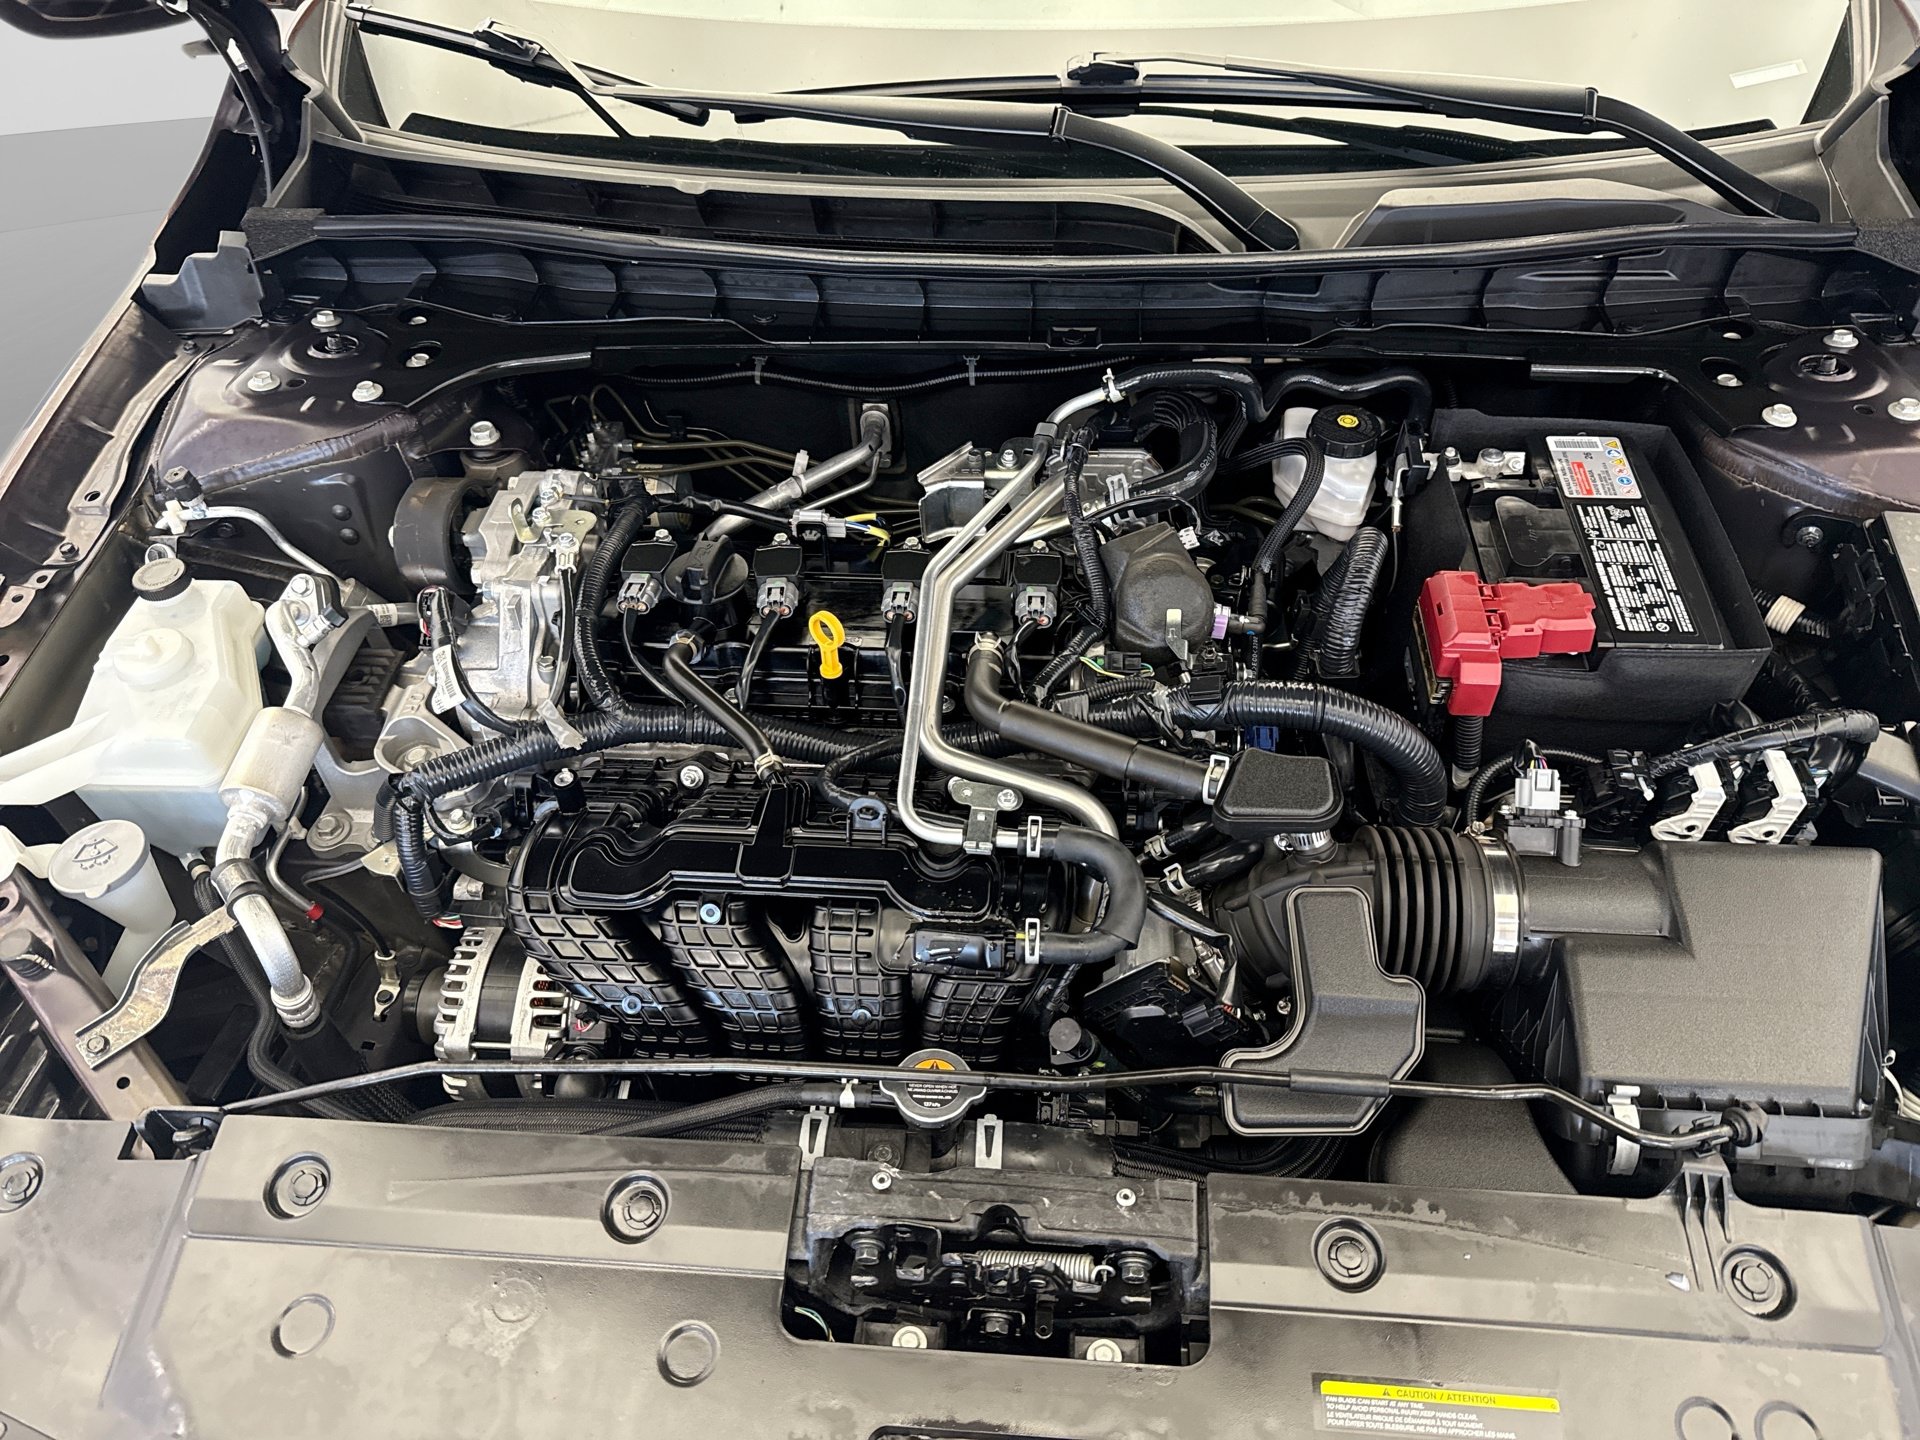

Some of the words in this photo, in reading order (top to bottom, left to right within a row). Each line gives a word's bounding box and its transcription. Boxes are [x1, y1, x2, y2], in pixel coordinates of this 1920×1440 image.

[1397, 1389, 1436, 1399] CAUTION
[1447, 1394, 1496, 1404] ATTENTION
[1335, 1412, 1372, 1421] VENTILATEUR
[1370, 1406, 1400, 1415] PERSONAL
[1436, 1411, 1457, 1419] HANDS
[1345, 1419, 1365, 1427] ÉVITER
[1366, 1421, 1383, 1429] TOUTE
[1426, 1426, 1438, 1434] PAS
